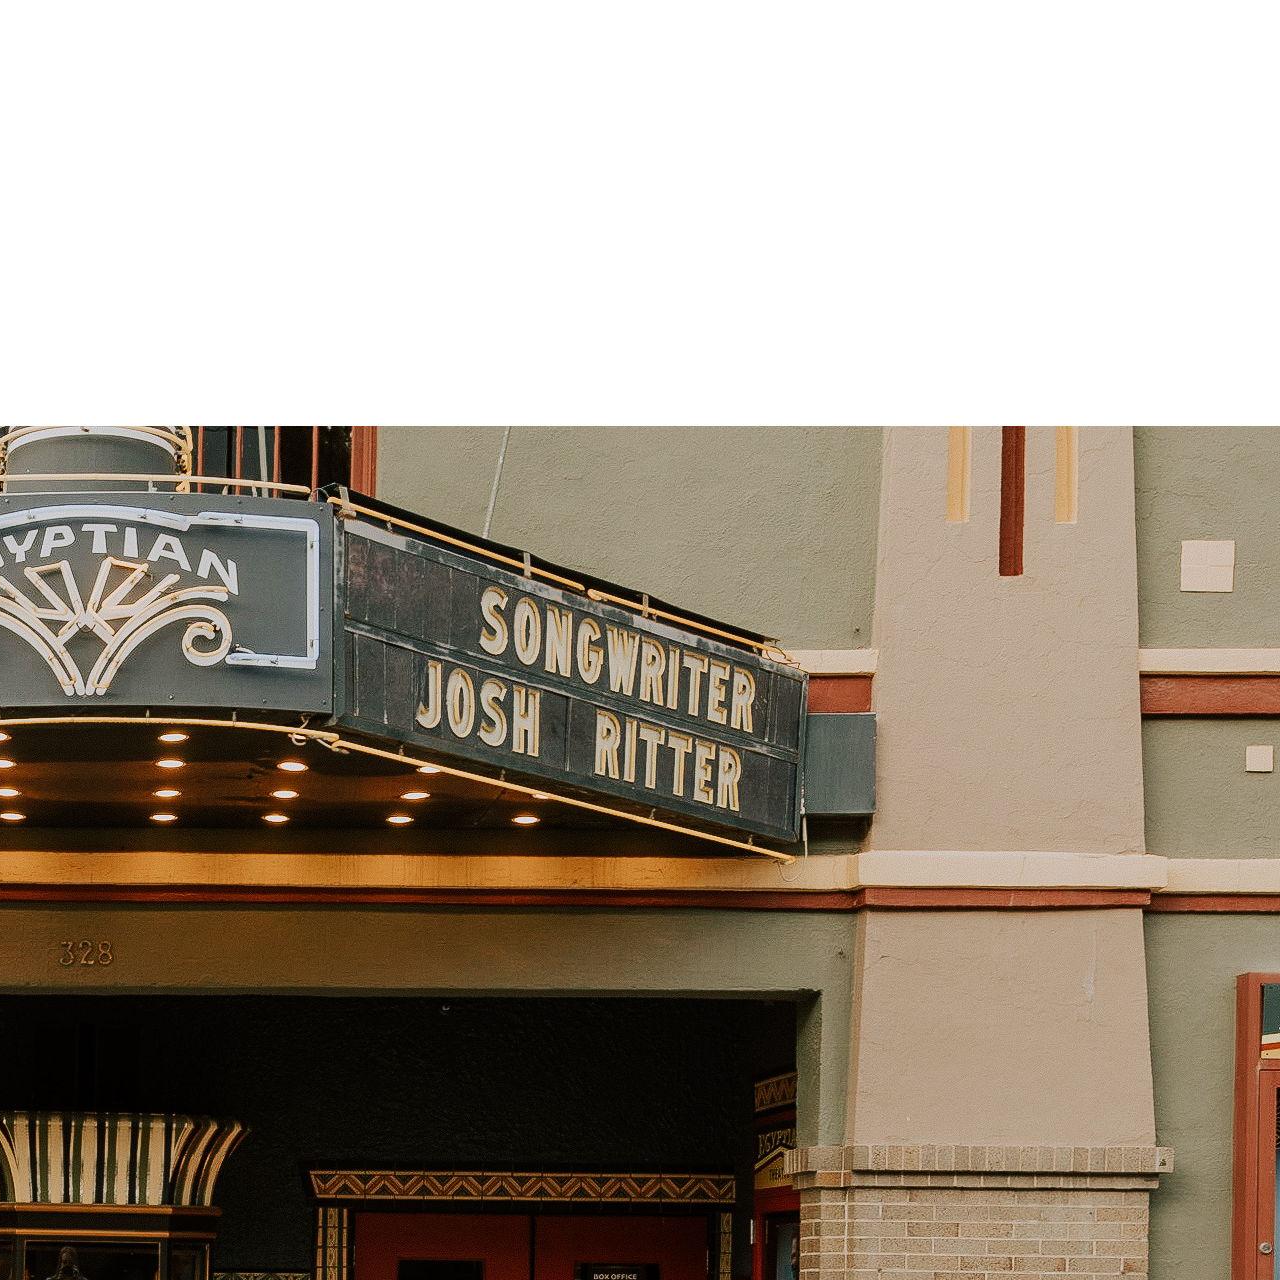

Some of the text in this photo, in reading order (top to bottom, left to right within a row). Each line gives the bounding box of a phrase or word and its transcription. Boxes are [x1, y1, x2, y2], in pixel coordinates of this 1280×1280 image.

[479, 584, 756, 734] SONGWRITER
[415, 658, 743, 813] JOSH RITTER
[60, 940, 113, 965] 328
